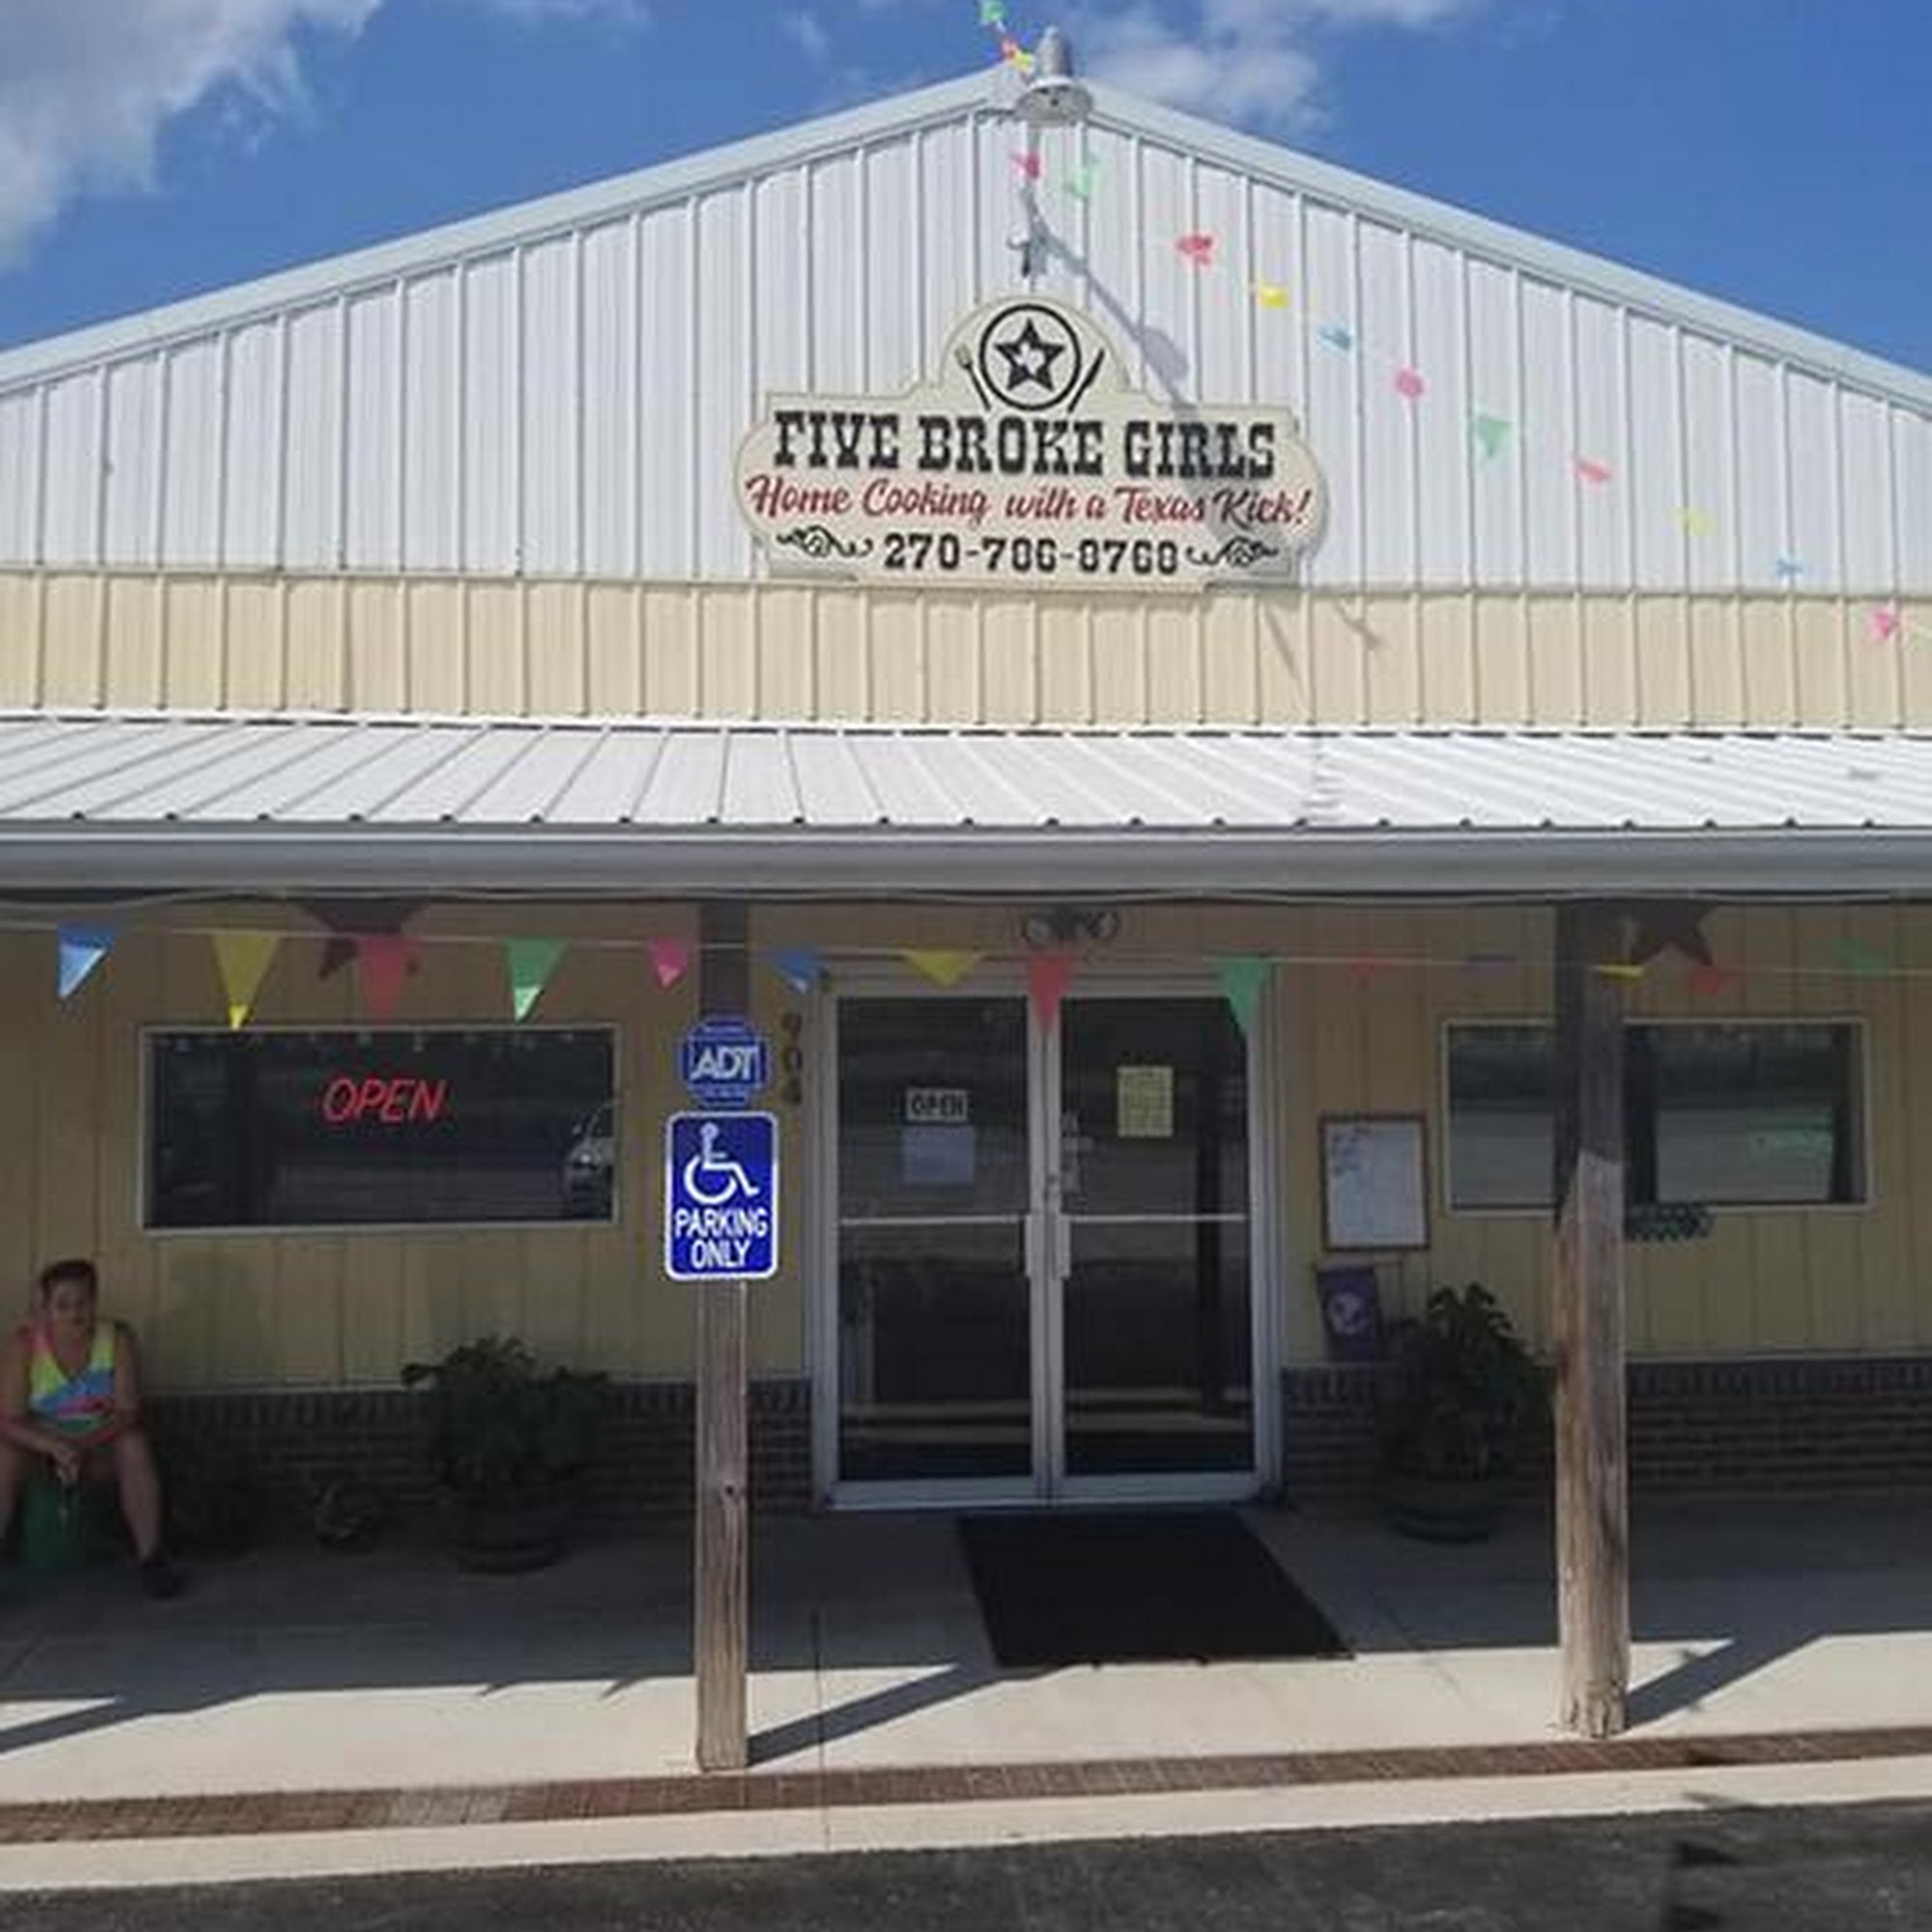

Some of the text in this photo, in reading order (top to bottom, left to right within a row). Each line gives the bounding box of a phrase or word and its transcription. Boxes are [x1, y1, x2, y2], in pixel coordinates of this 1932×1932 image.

[774, 411, 1275, 479] FIVE BROKE GIRLS
[746, 474, 1312, 531] Home Cooking with a Texas Kick!
[690, 1046, 759, 1080] ADT
[322, 1076, 446, 1122] OPEN
[675, 1208, 769, 1237] PARKING
[690, 1238, 752, 1269] ONLY
